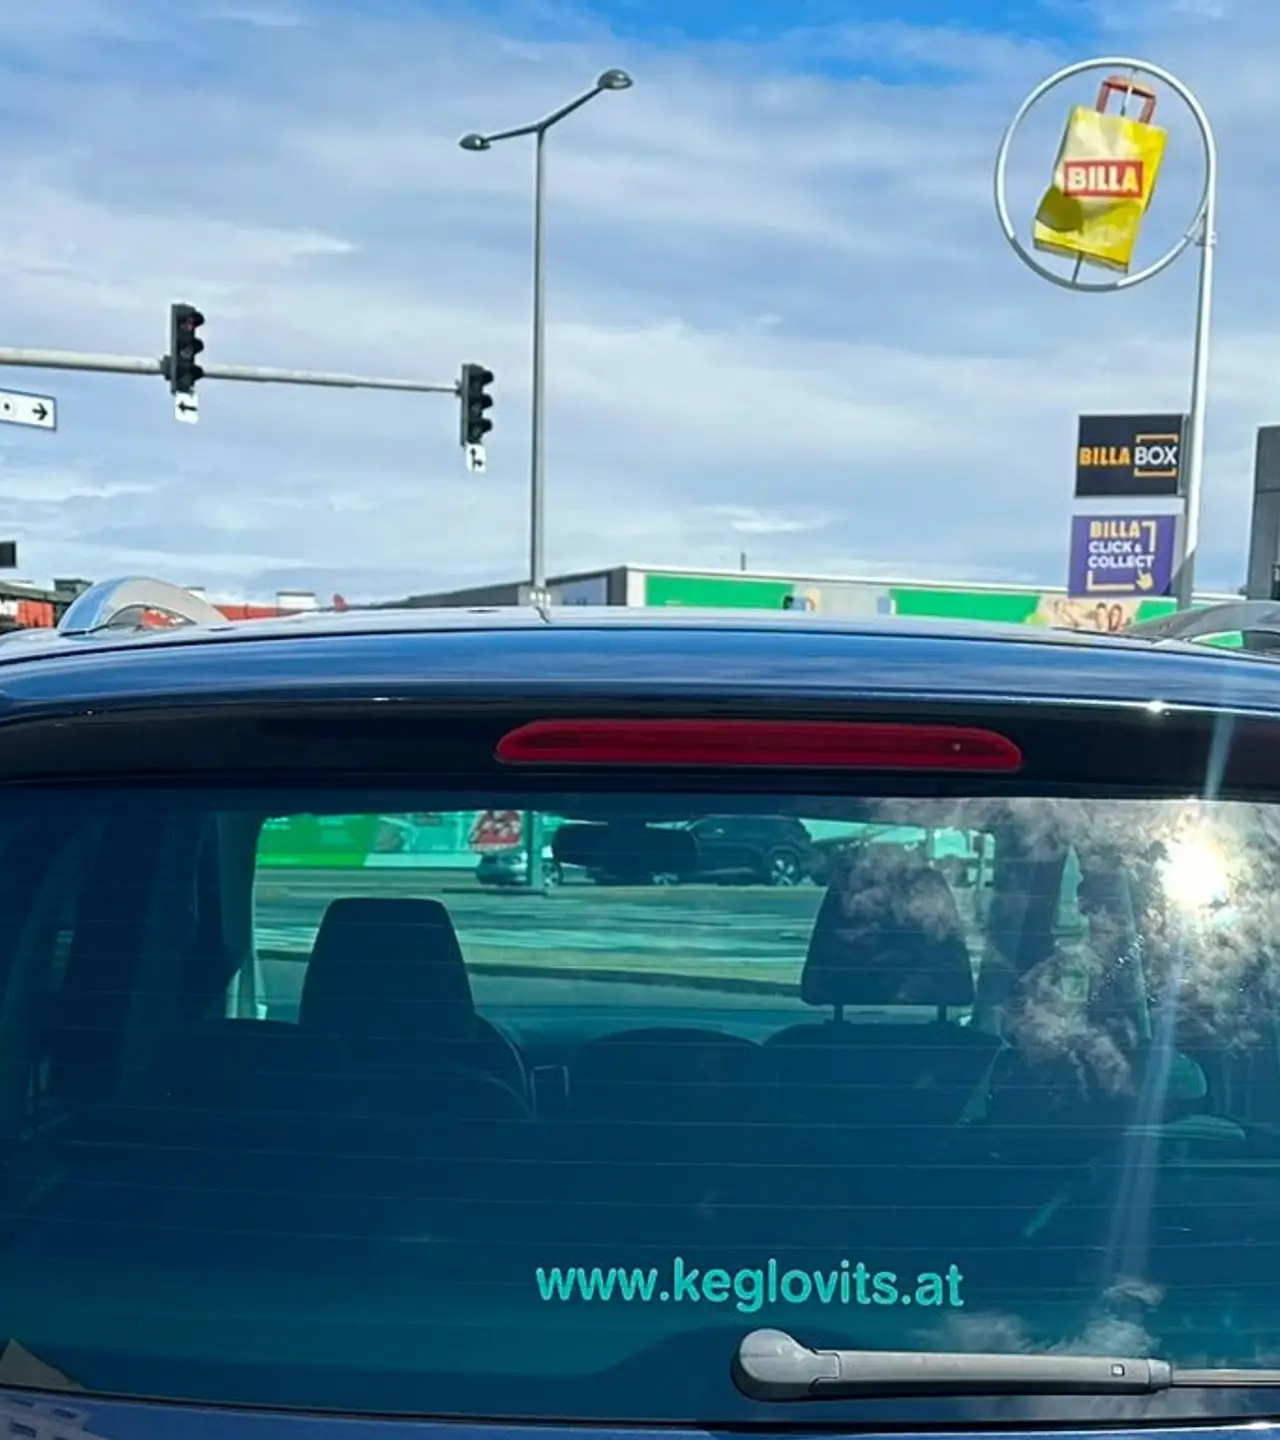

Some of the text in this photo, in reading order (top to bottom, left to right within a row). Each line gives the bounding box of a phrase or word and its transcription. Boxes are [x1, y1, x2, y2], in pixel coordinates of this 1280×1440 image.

[1067, 165, 1139, 192] BILLA
[1079, 446, 1178, 466] BILLA BOX
[1089, 520, 1141, 539] BILLA
[1088, 540, 1132, 554] CLICK
[1087, 555, 1155, 569] COLLECT
[535, 1256, 964, 1313] www.keglovits.at
